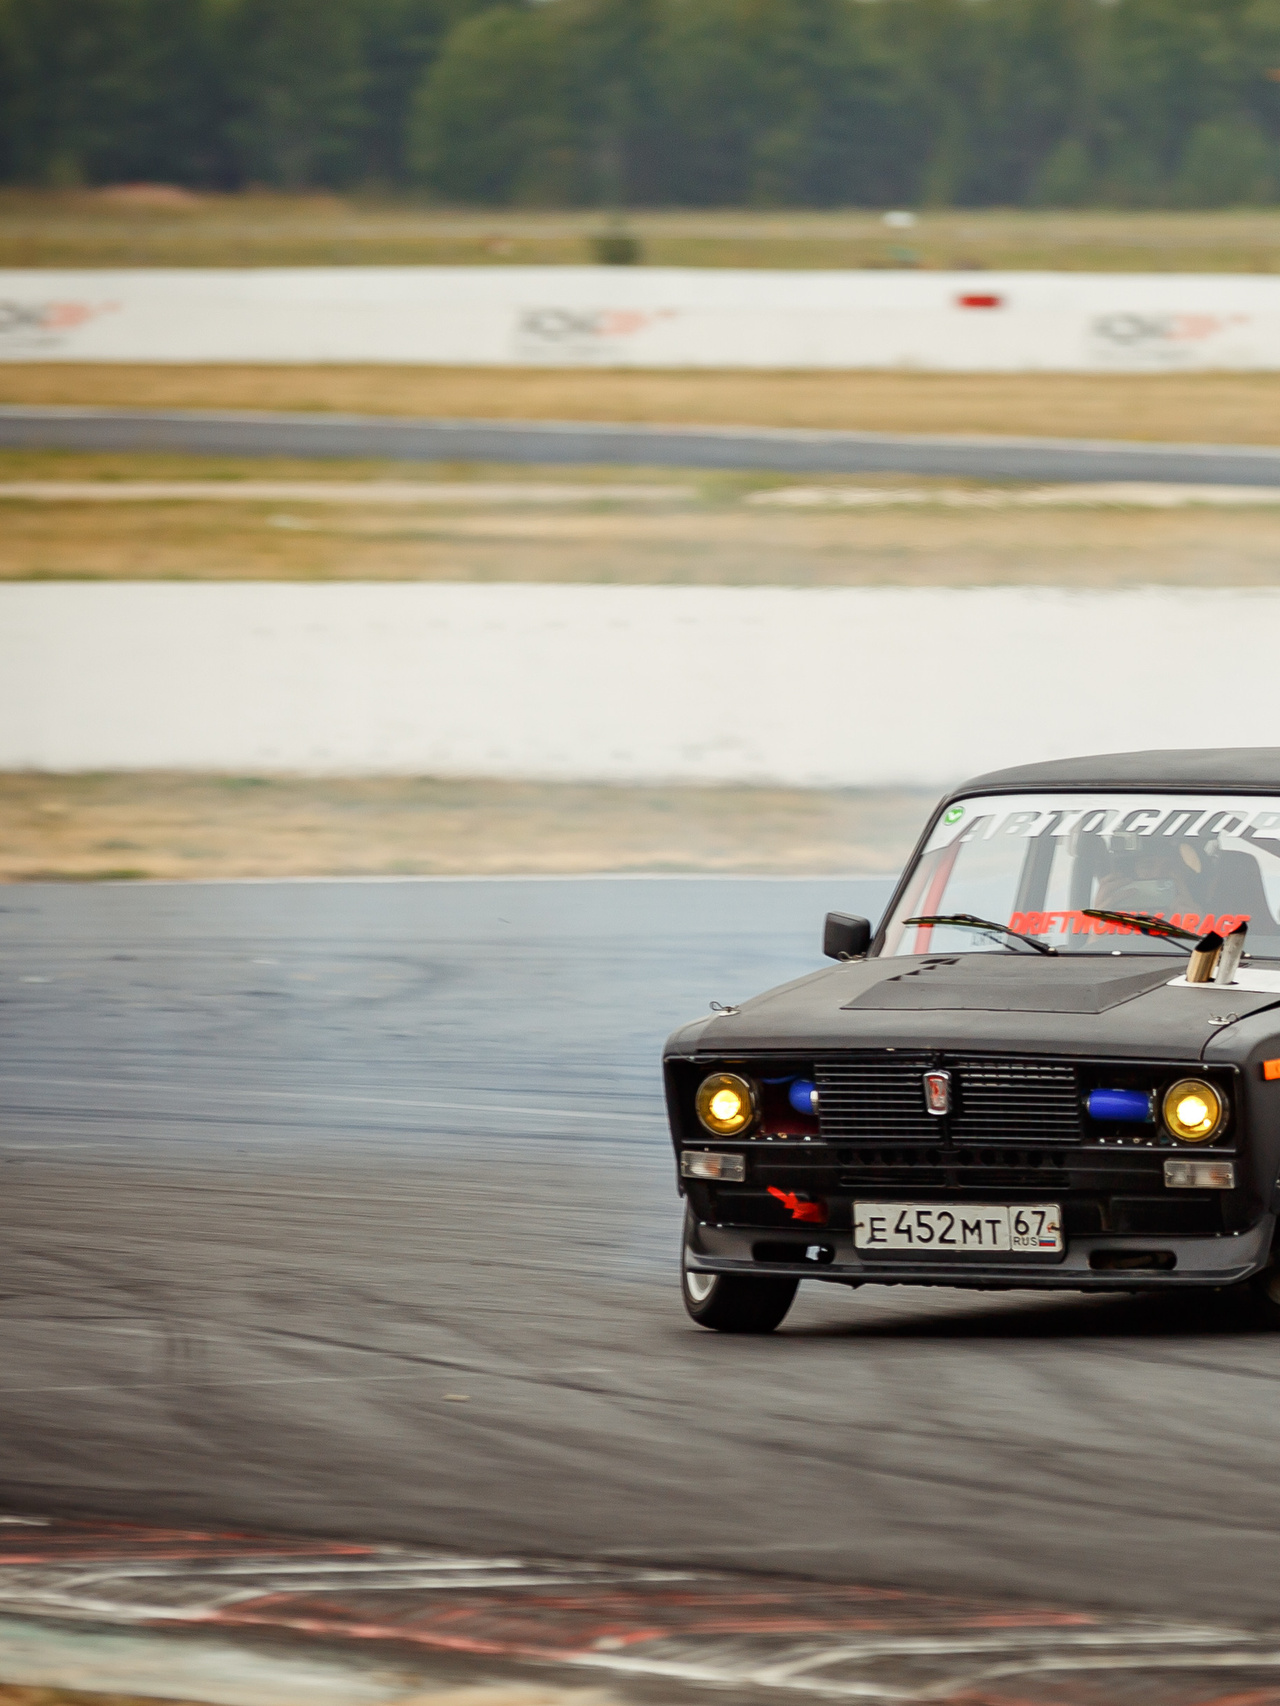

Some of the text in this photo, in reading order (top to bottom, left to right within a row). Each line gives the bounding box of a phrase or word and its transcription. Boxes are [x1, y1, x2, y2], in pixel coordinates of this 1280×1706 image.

[868, 1210, 1046, 1245] Е452МТ 67
[1013, 1236, 1038, 1247] RUS
